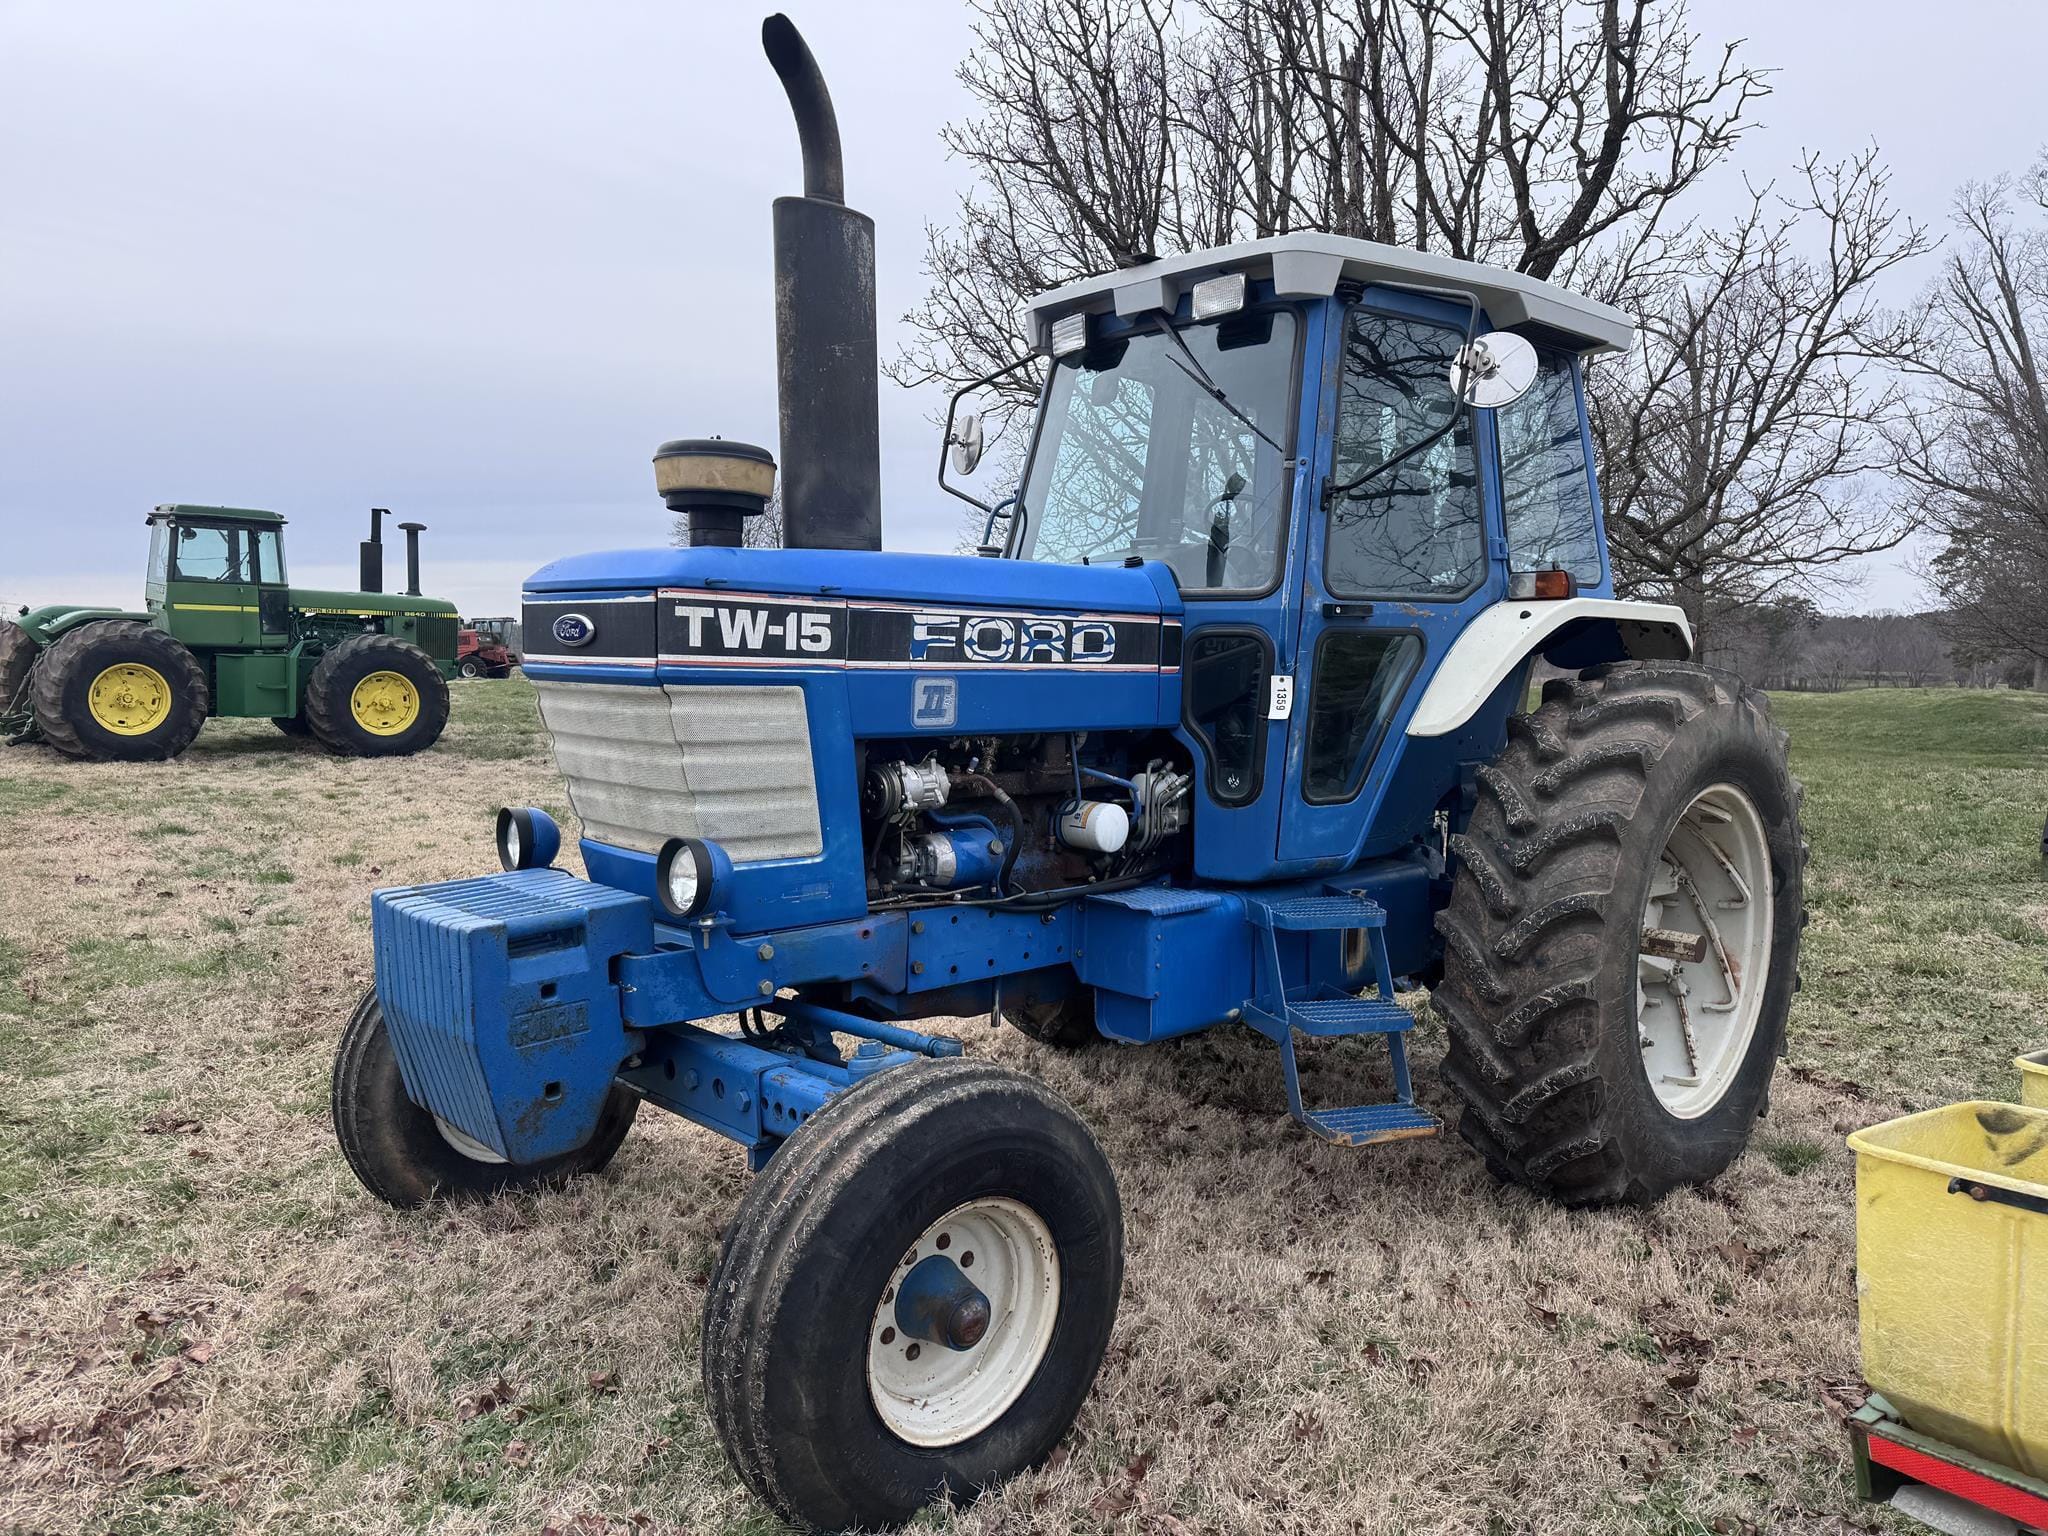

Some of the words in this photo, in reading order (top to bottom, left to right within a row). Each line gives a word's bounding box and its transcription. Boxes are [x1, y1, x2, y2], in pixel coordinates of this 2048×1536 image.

[559, 619, 581, 637] Ford
[674, 605, 832, 652] TW-15
[910, 614, 1116, 663] FORD
[1275, 687, 1288, 711] 1359
